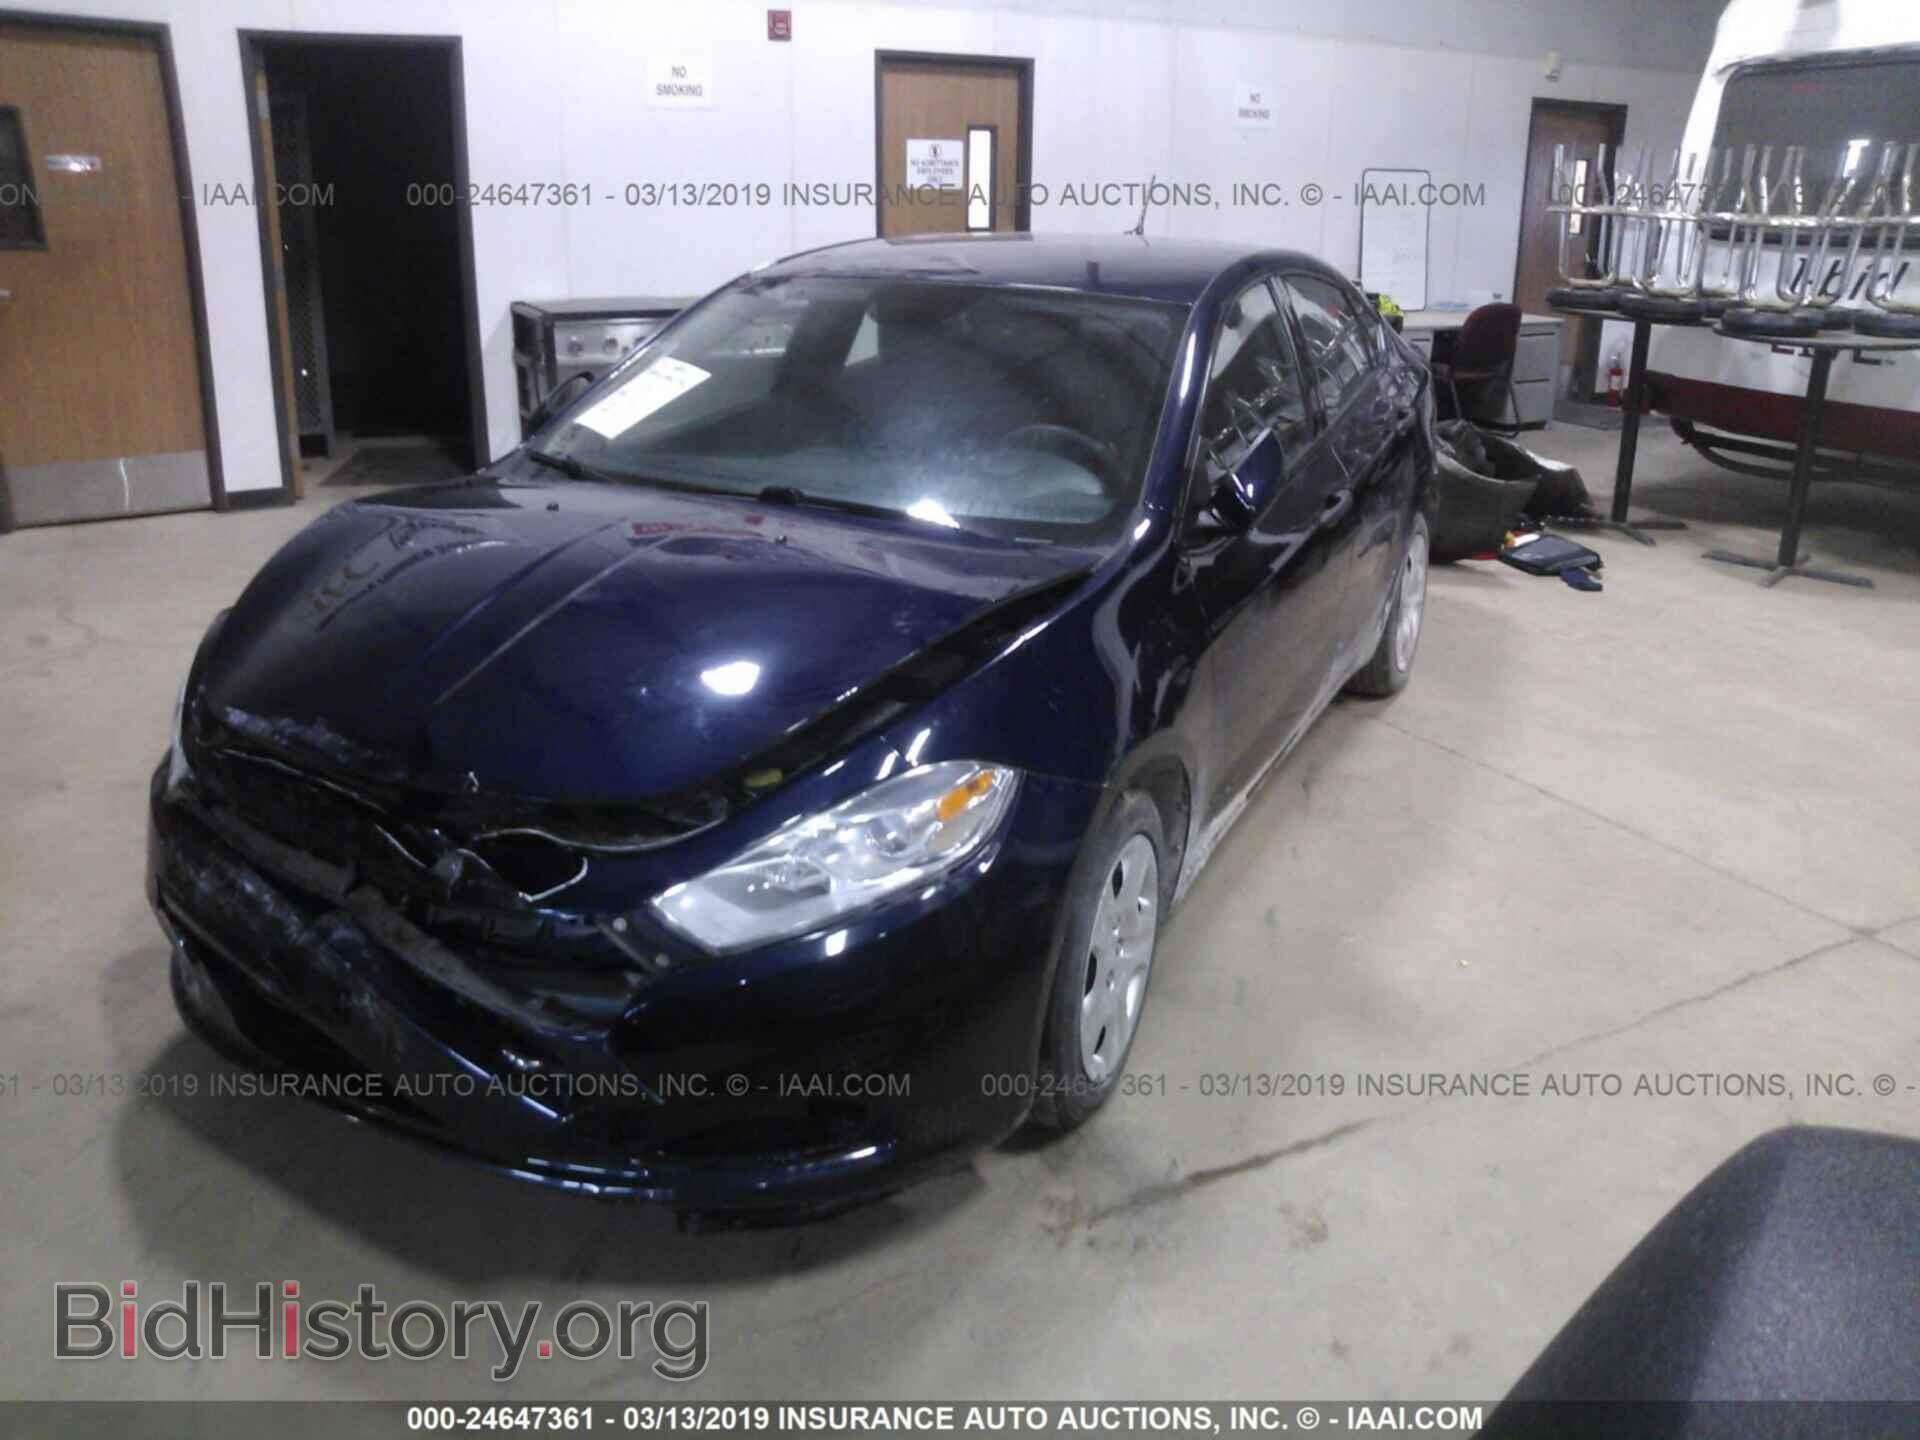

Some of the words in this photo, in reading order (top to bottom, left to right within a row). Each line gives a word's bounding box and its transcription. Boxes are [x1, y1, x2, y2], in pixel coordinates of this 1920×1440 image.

[671, 66, 687, 78] NO
[656, 83, 703, 96] SMOKING
[1250, 93, 1261, 104] NO
